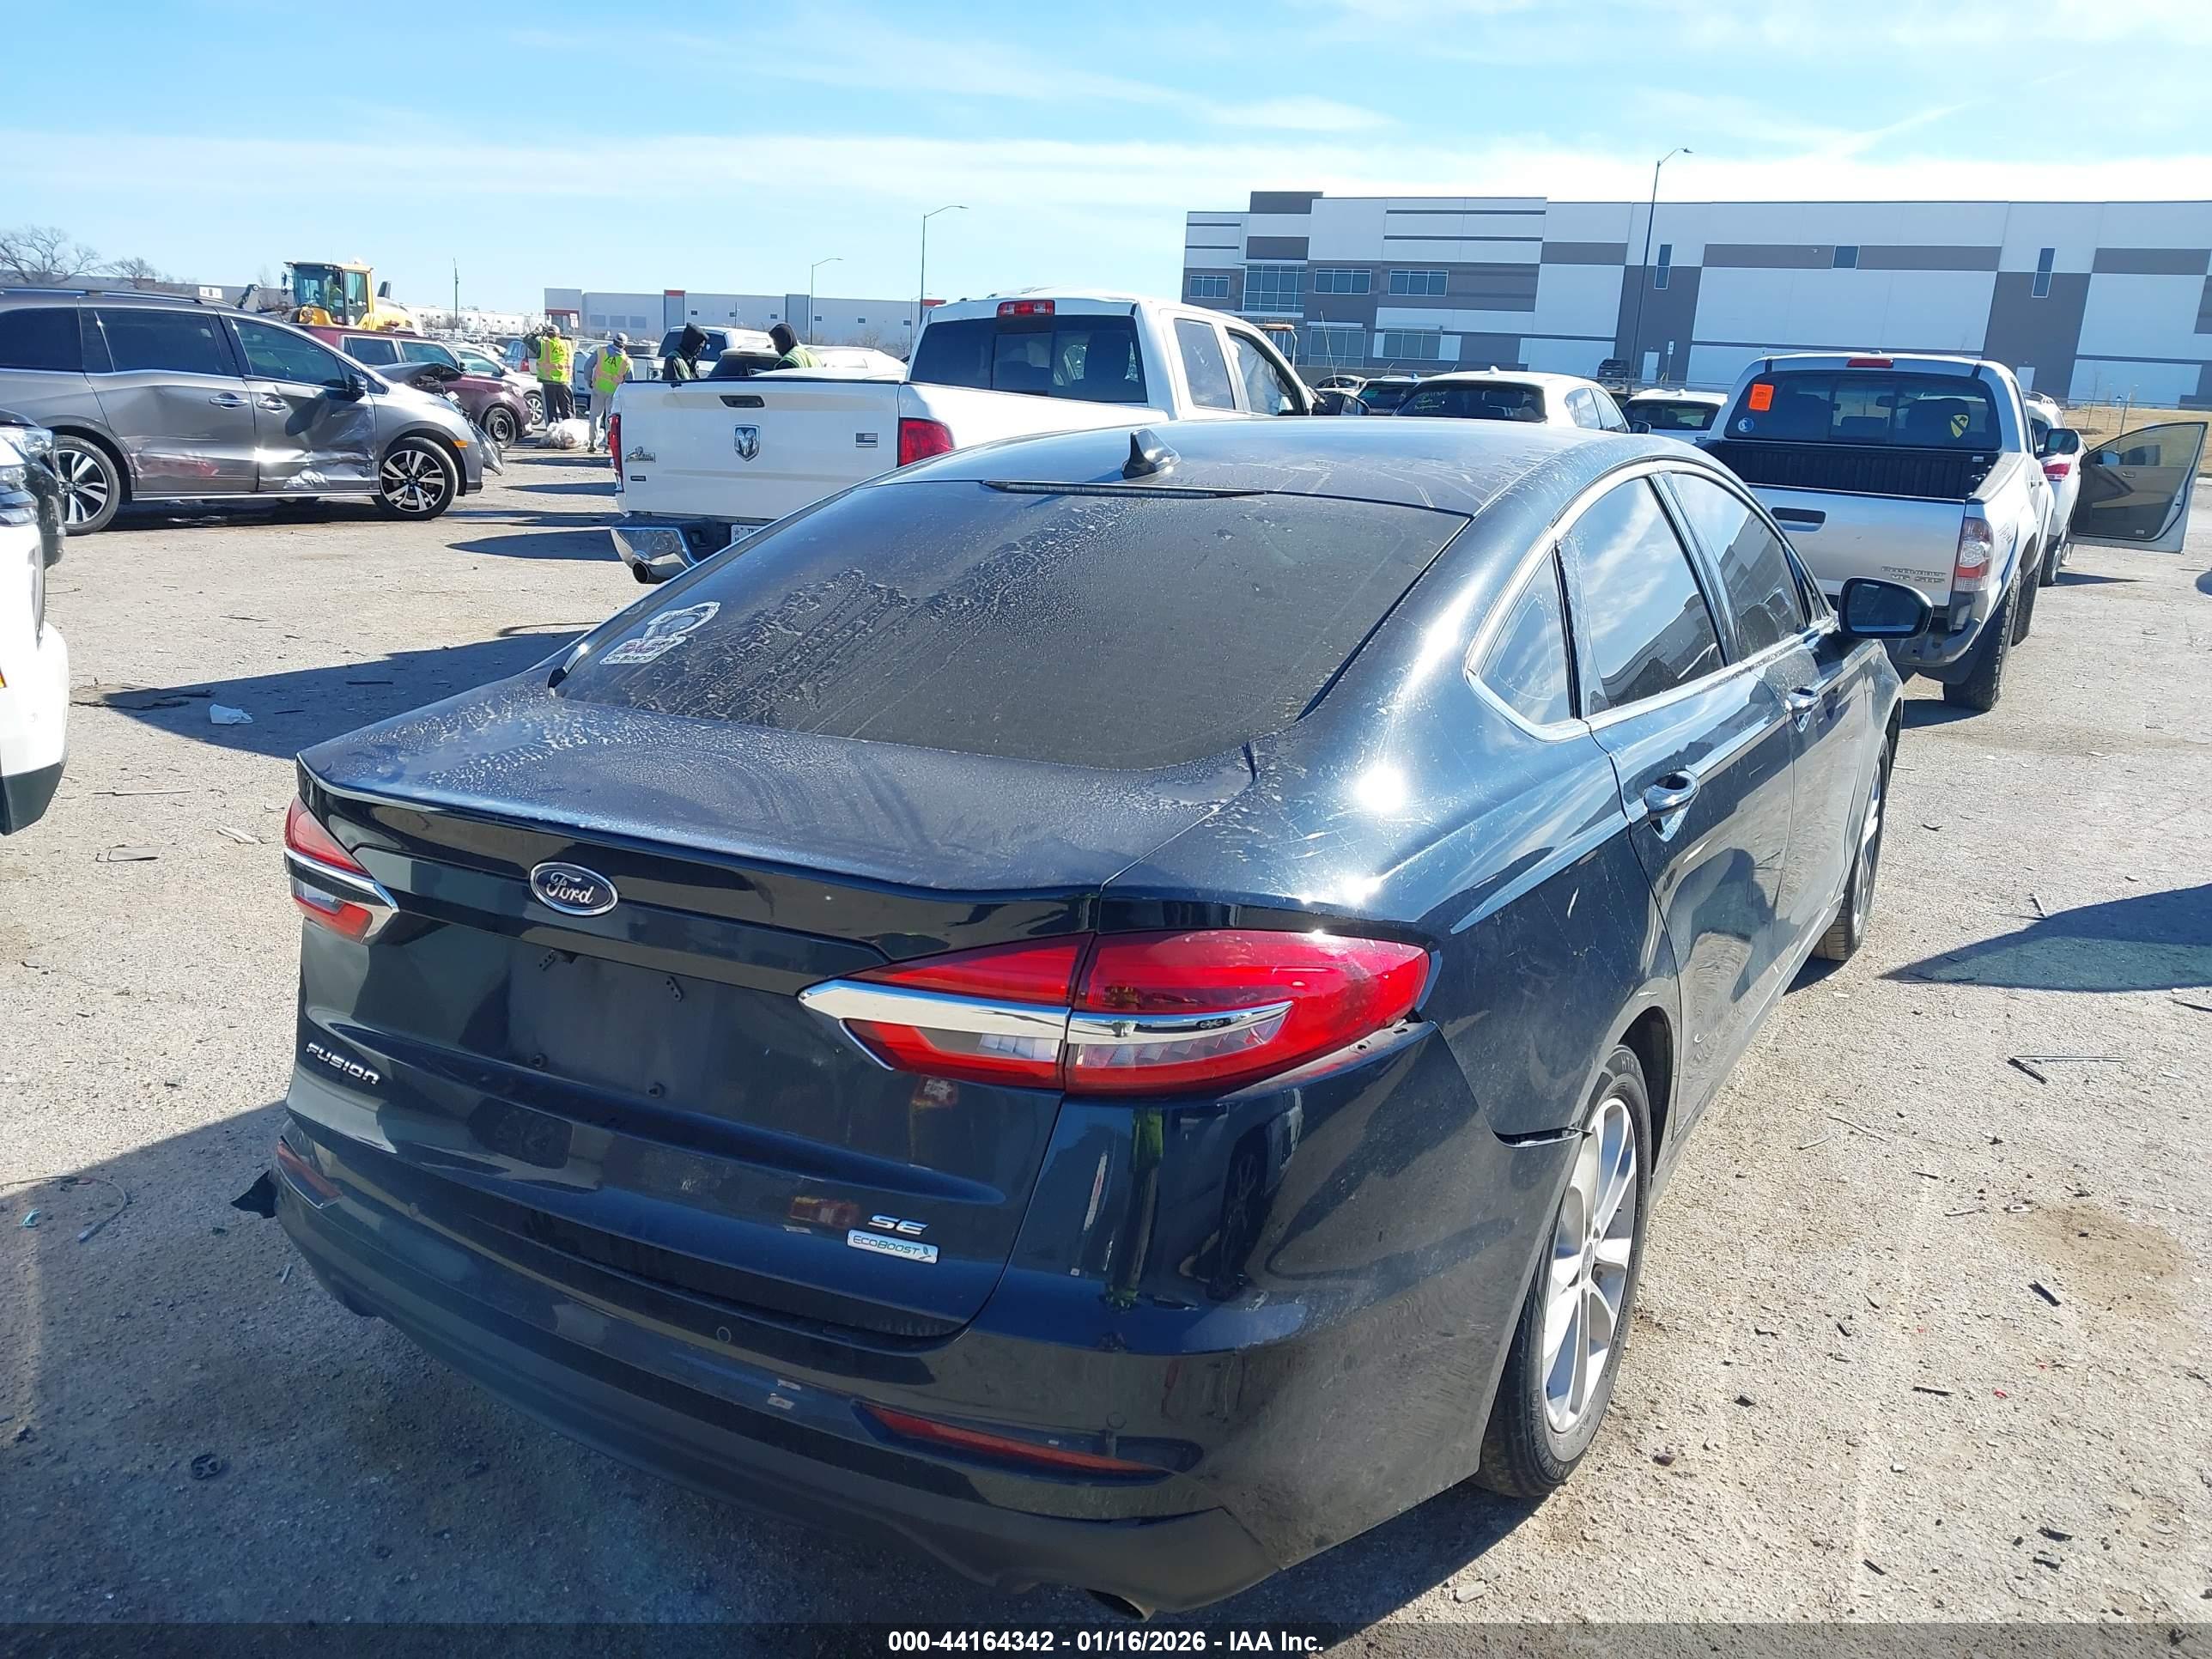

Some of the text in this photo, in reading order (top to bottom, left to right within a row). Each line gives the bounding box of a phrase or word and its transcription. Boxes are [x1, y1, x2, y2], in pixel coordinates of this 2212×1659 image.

[546, 872, 594, 904] Ford
[306, 1042, 380, 1085] FUSION
[868, 1215, 929, 1236] SE
